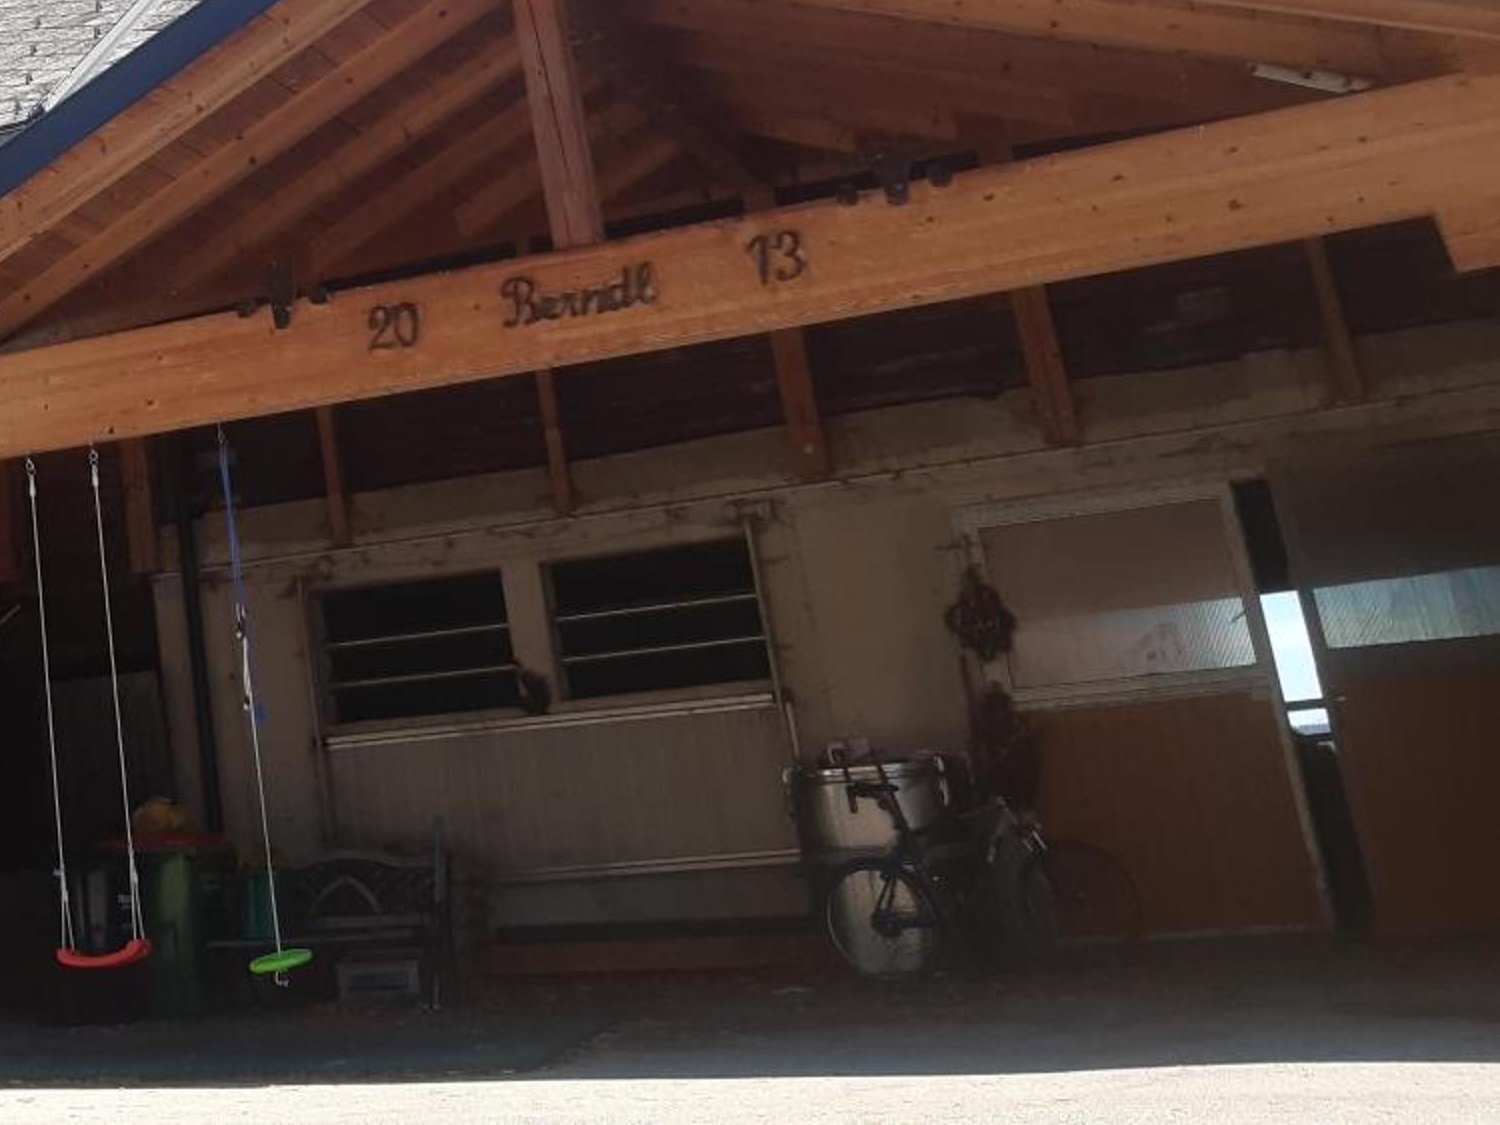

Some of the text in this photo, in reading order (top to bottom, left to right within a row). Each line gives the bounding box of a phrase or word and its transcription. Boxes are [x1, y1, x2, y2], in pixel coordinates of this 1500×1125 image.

[367, 230, 806, 352] 20 Berndl 13
